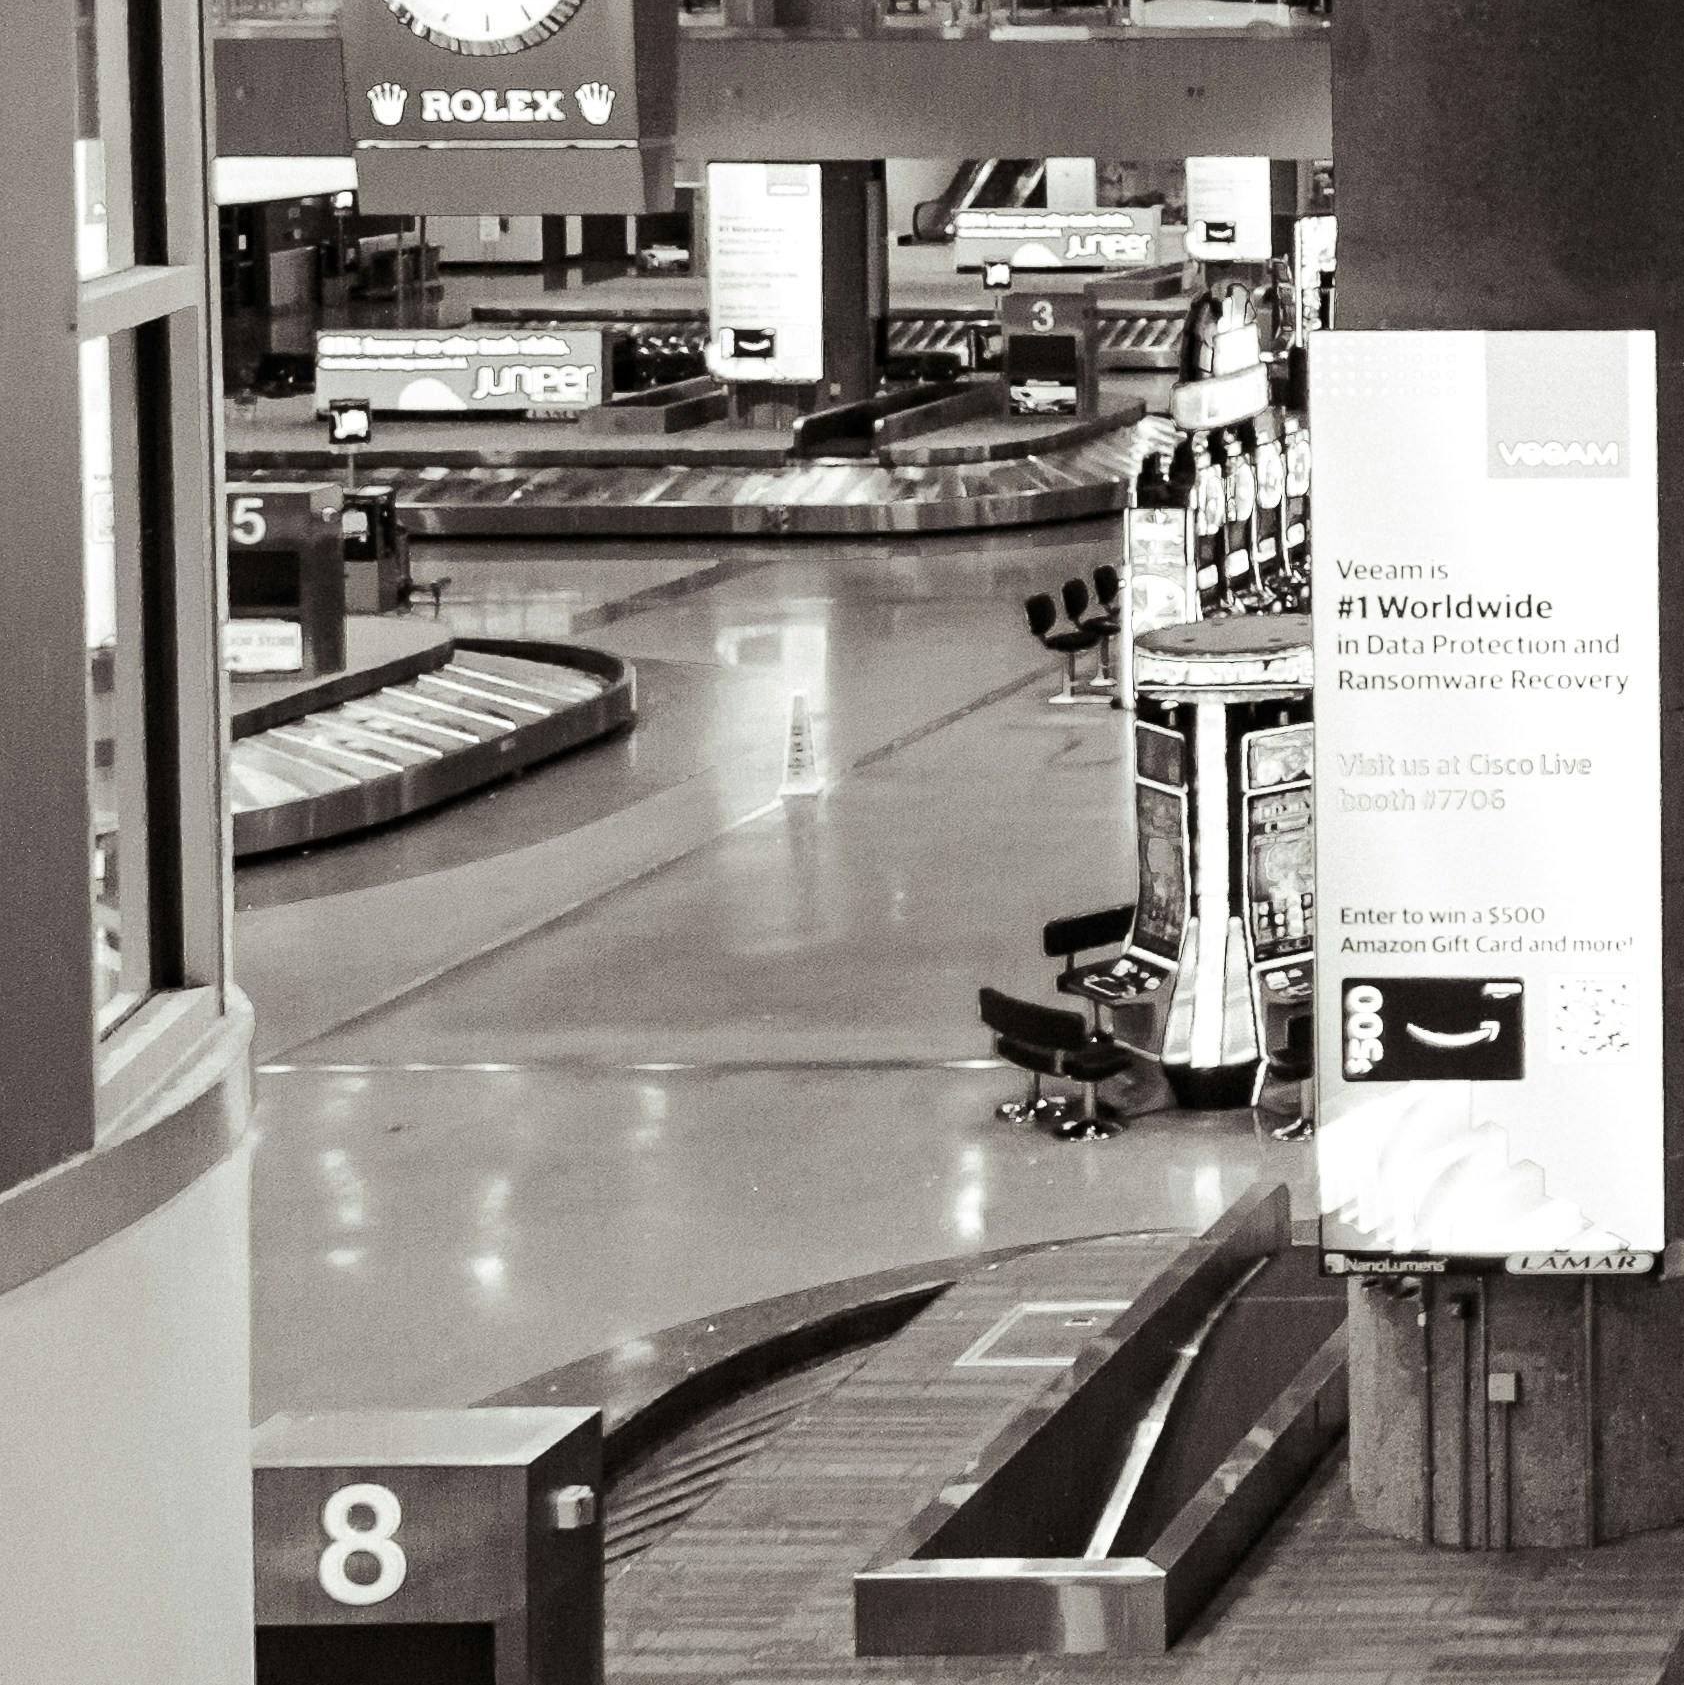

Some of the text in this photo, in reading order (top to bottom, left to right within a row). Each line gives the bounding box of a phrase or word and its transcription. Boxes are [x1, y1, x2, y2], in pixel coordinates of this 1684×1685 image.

[421, 89, 565, 123] ROLEX
[1031, 300, 1055, 333] 3
[230, 498, 267, 546] 5
[1336, 559, 1449, 581] Veeam is
[1336, 594, 1554, 621] #1 Worldwide
[1336, 633, 1620, 656] in Data Protection and
[1336, 669, 1629, 696] Ransomware Recovery
[1336, 752, 1593, 777] Visit us at Cisco Live
[1336, 787, 1506, 812] booth #7706
[1341, 906, 1546, 926] Enter to win a $500
[1340, 935, 1426, 955] Amazon
[1432, 934, 1470, 954] Gift
[1475, 935, 1523, 954] Card
[1528, 935, 1567, 954] and
[1346, 985, 1385, 1076] $500
[1520, 1255, 1638, 1269] LAMAR
[317, 1482, 408, 1607] 8
